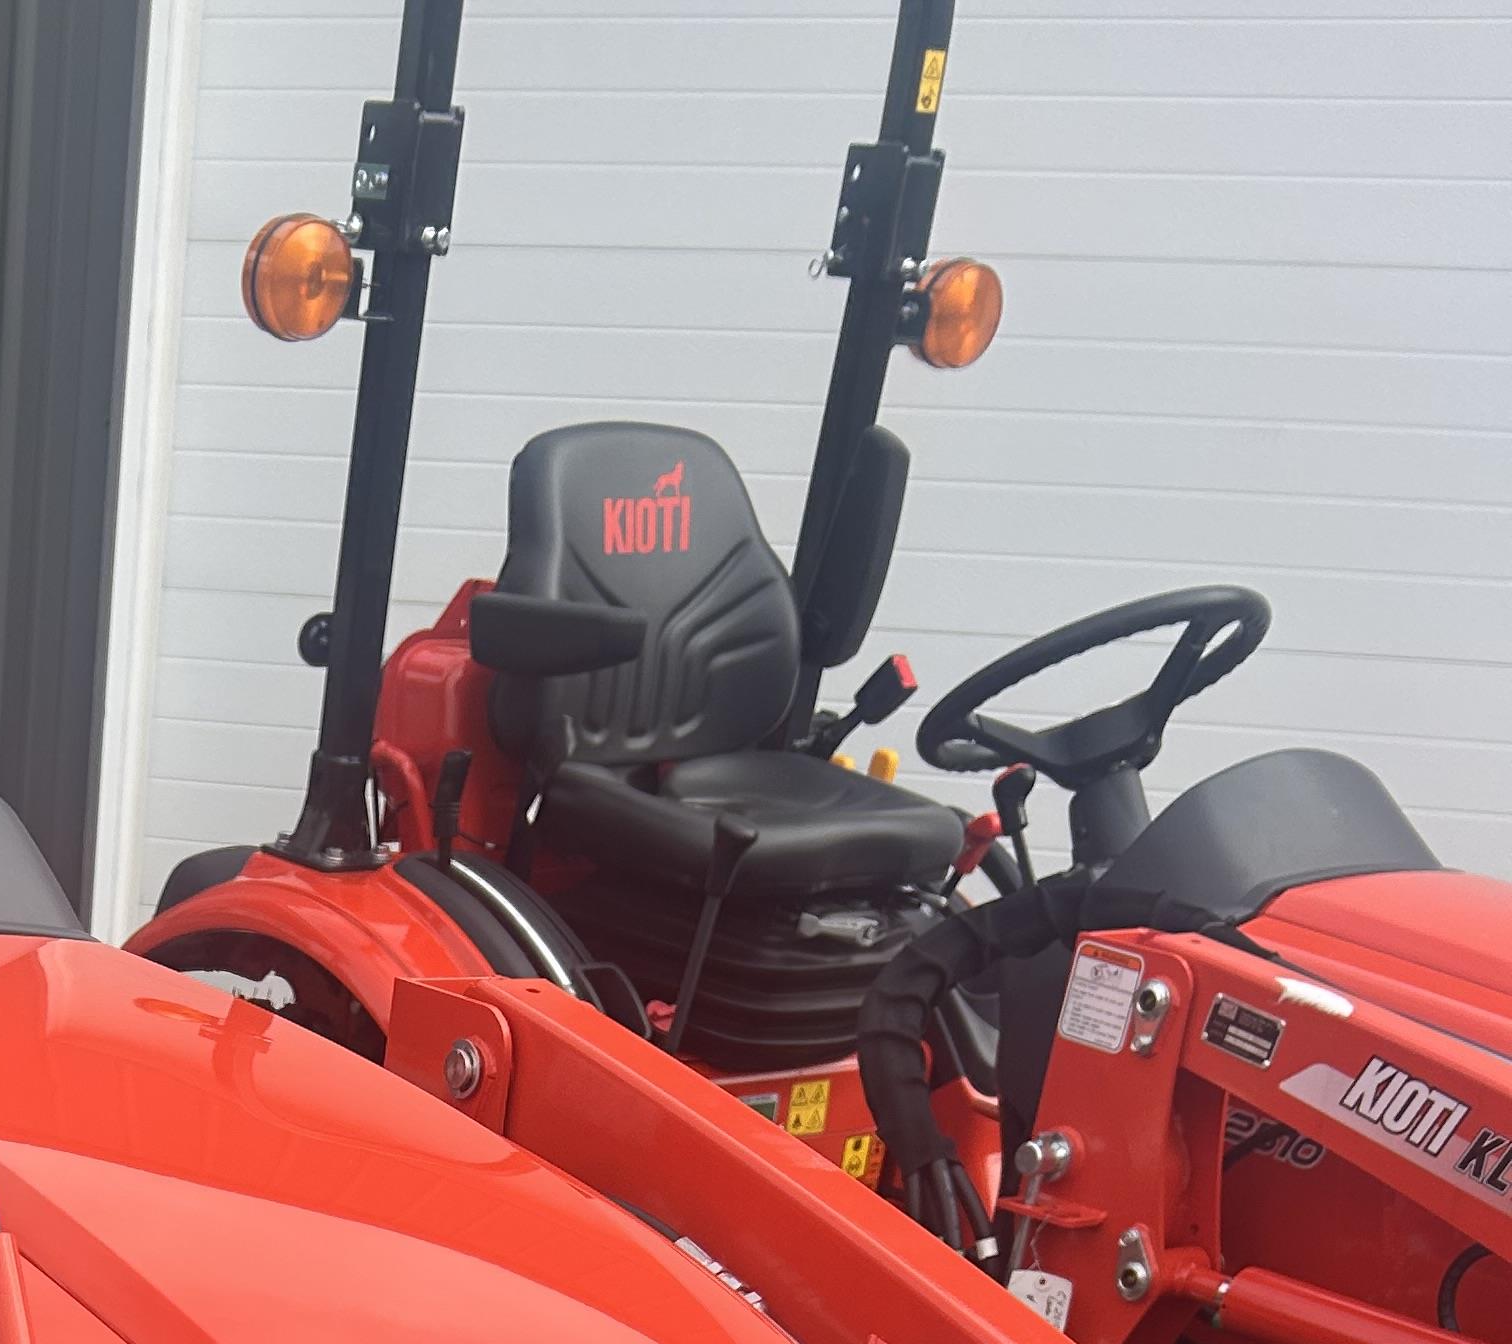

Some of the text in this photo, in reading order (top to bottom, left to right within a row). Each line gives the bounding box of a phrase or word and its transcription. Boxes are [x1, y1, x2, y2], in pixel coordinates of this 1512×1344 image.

[602, 496, 692, 556] KIOTI
[1339, 1055, 1512, 1195] KIOTI KL
